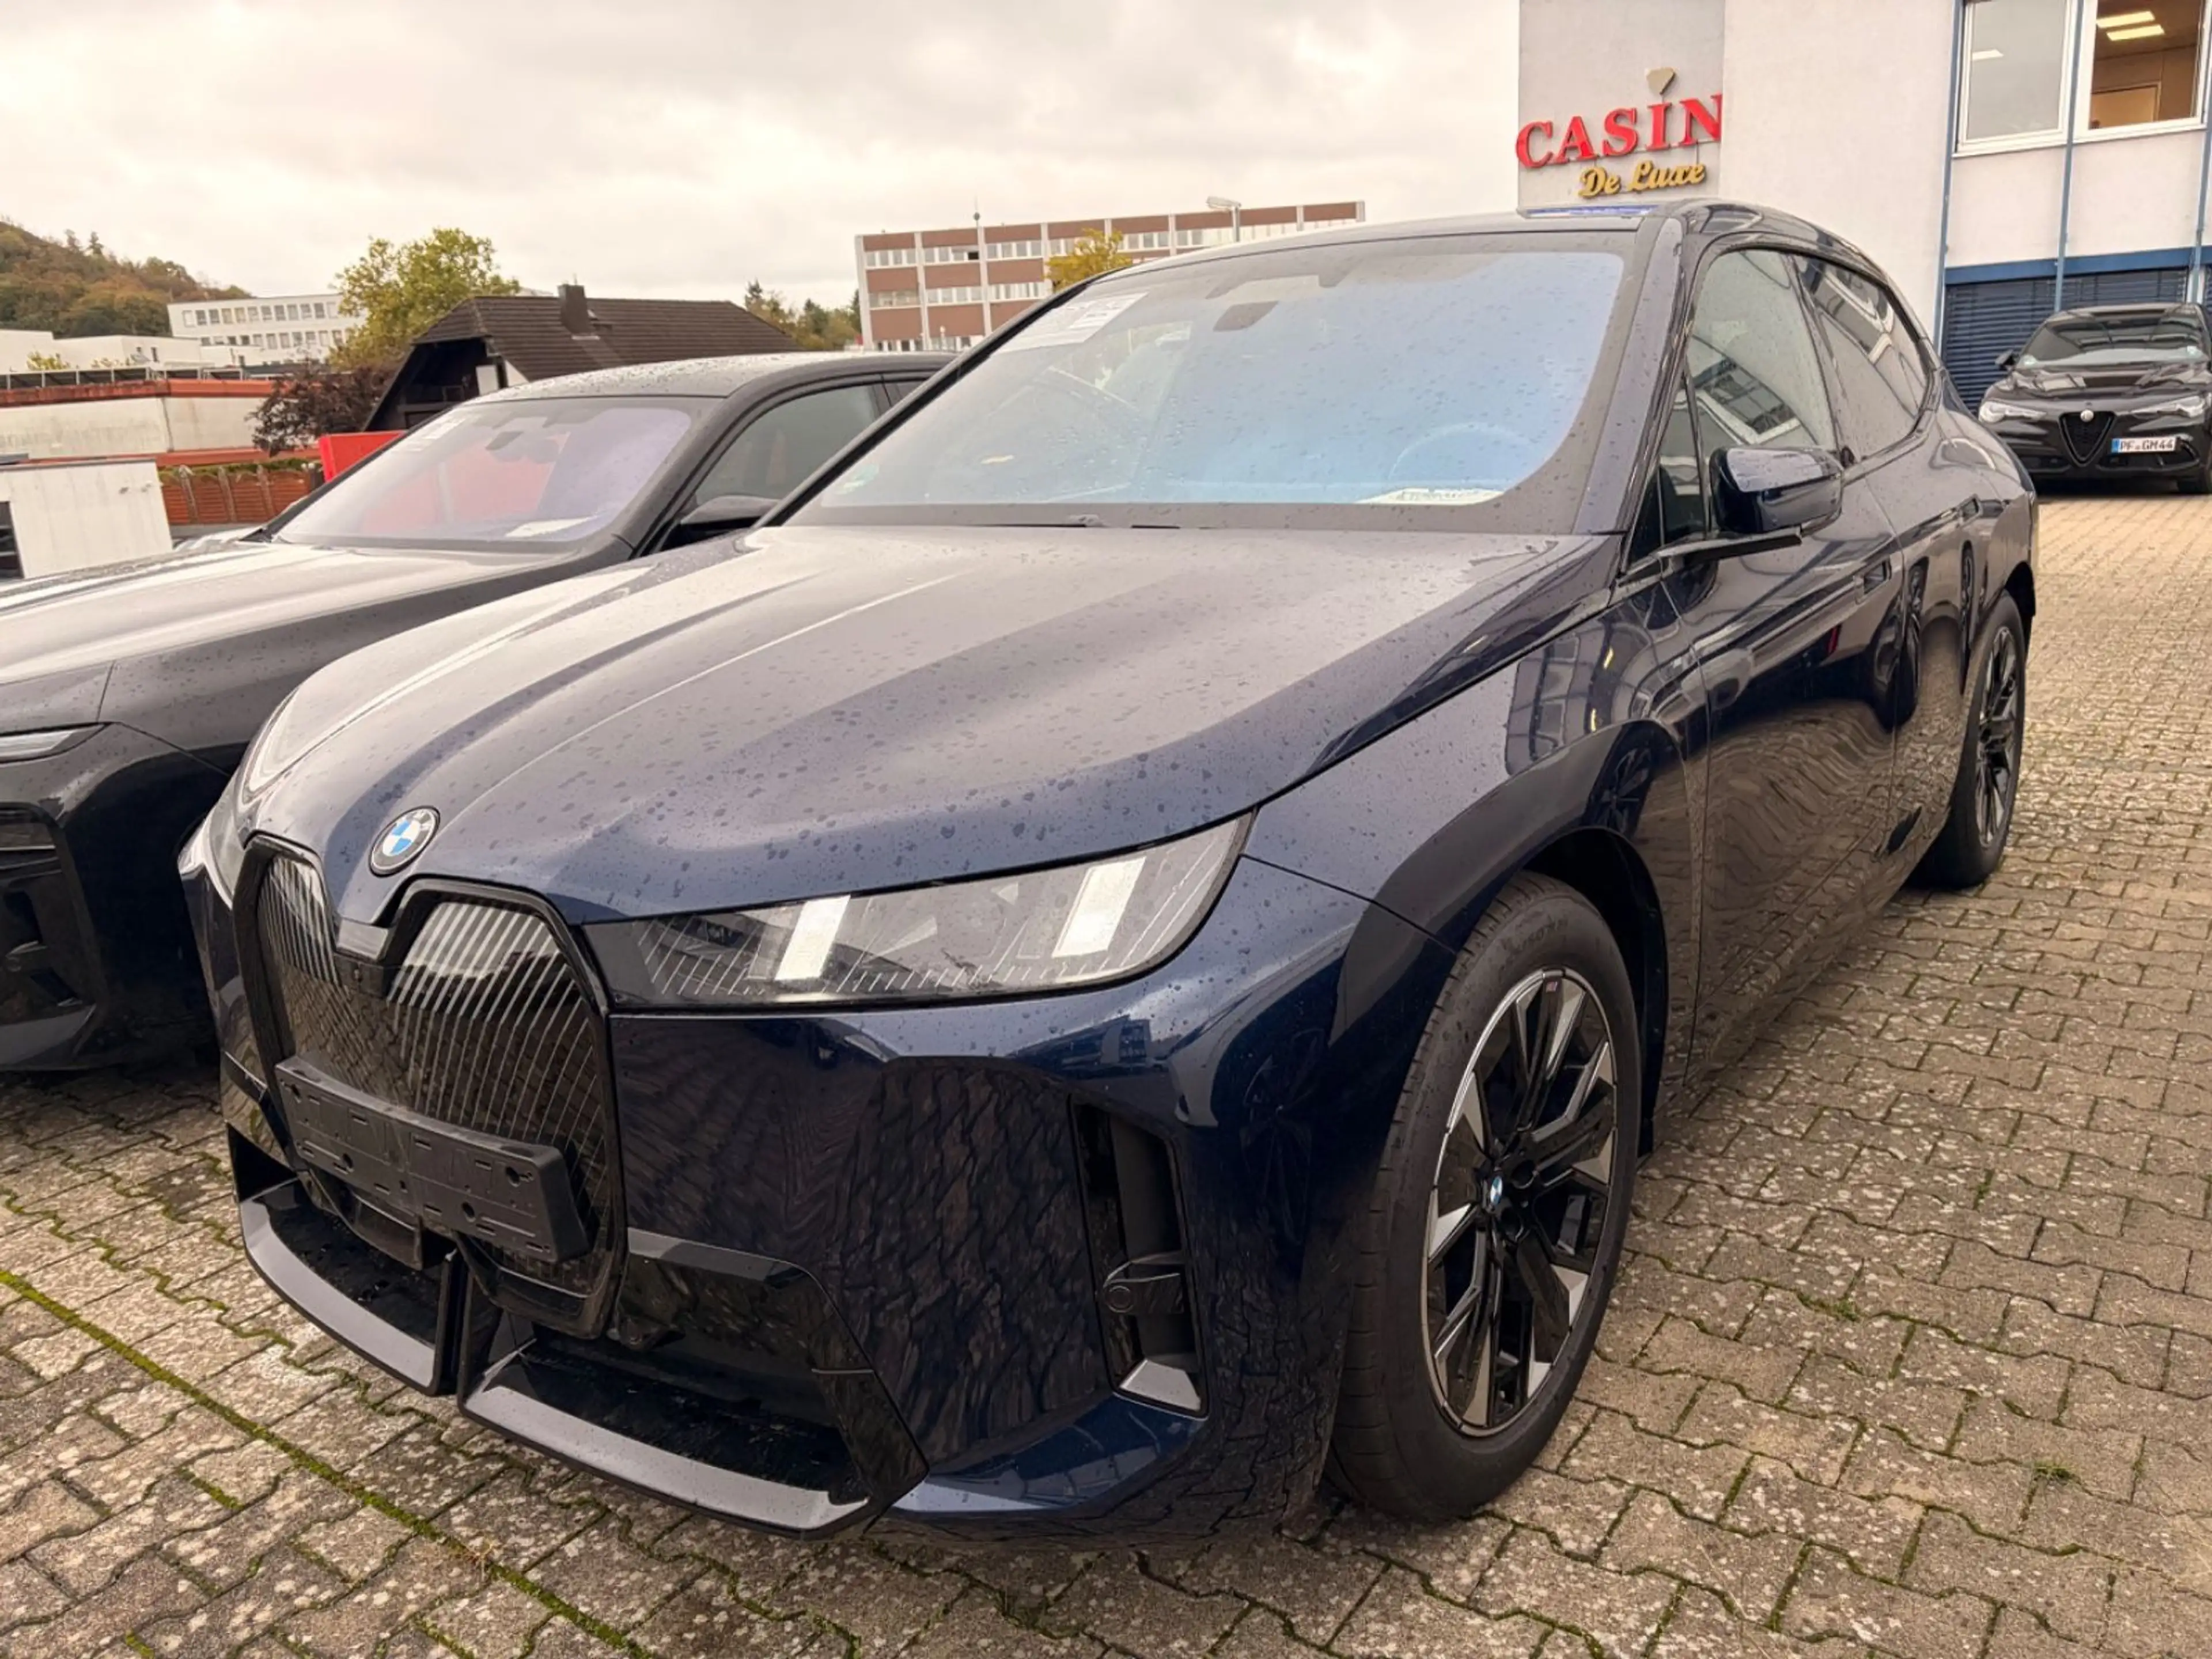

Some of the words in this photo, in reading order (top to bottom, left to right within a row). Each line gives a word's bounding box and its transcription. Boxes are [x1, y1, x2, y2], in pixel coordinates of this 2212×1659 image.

[1516, 94, 1722, 168] CASIN
[1577, 165, 1620, 198] De
[1628, 161, 1706, 191] Luxe
